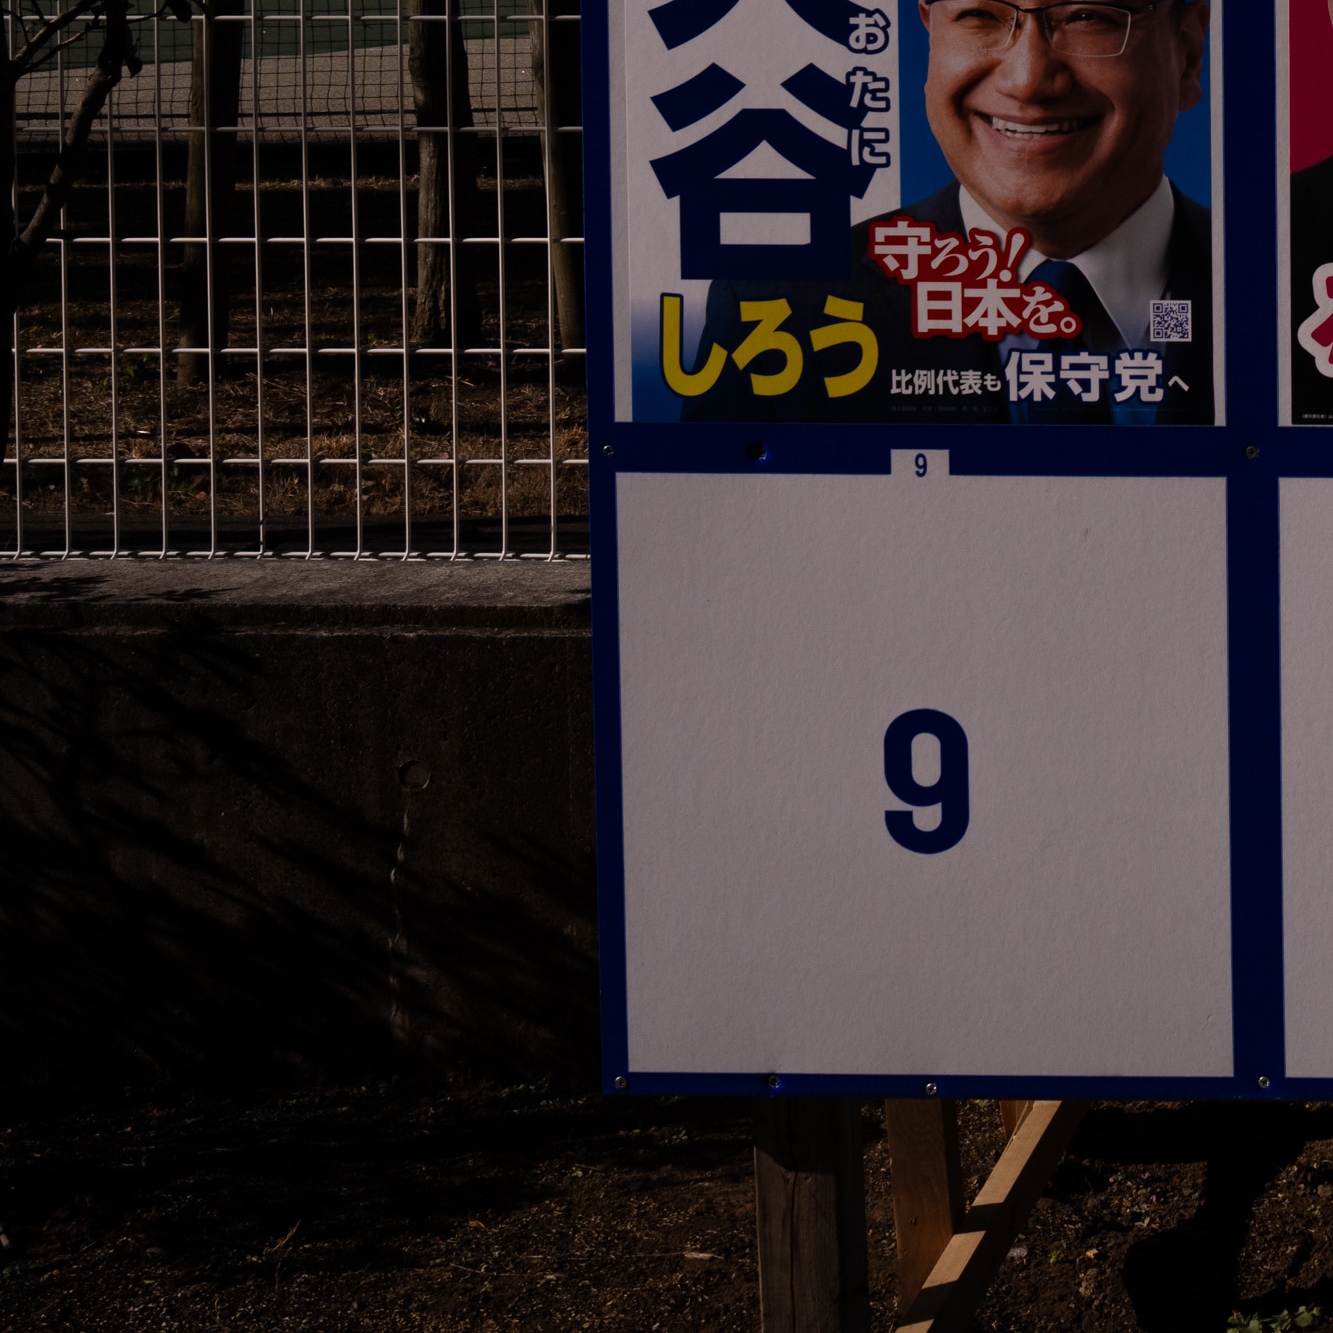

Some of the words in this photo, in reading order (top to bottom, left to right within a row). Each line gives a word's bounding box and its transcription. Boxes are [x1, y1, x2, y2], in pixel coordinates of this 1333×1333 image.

[661, 295, 880, 399] しろう
[914, 453, 927, 478] 9
[882, 709, 970, 856] 9
